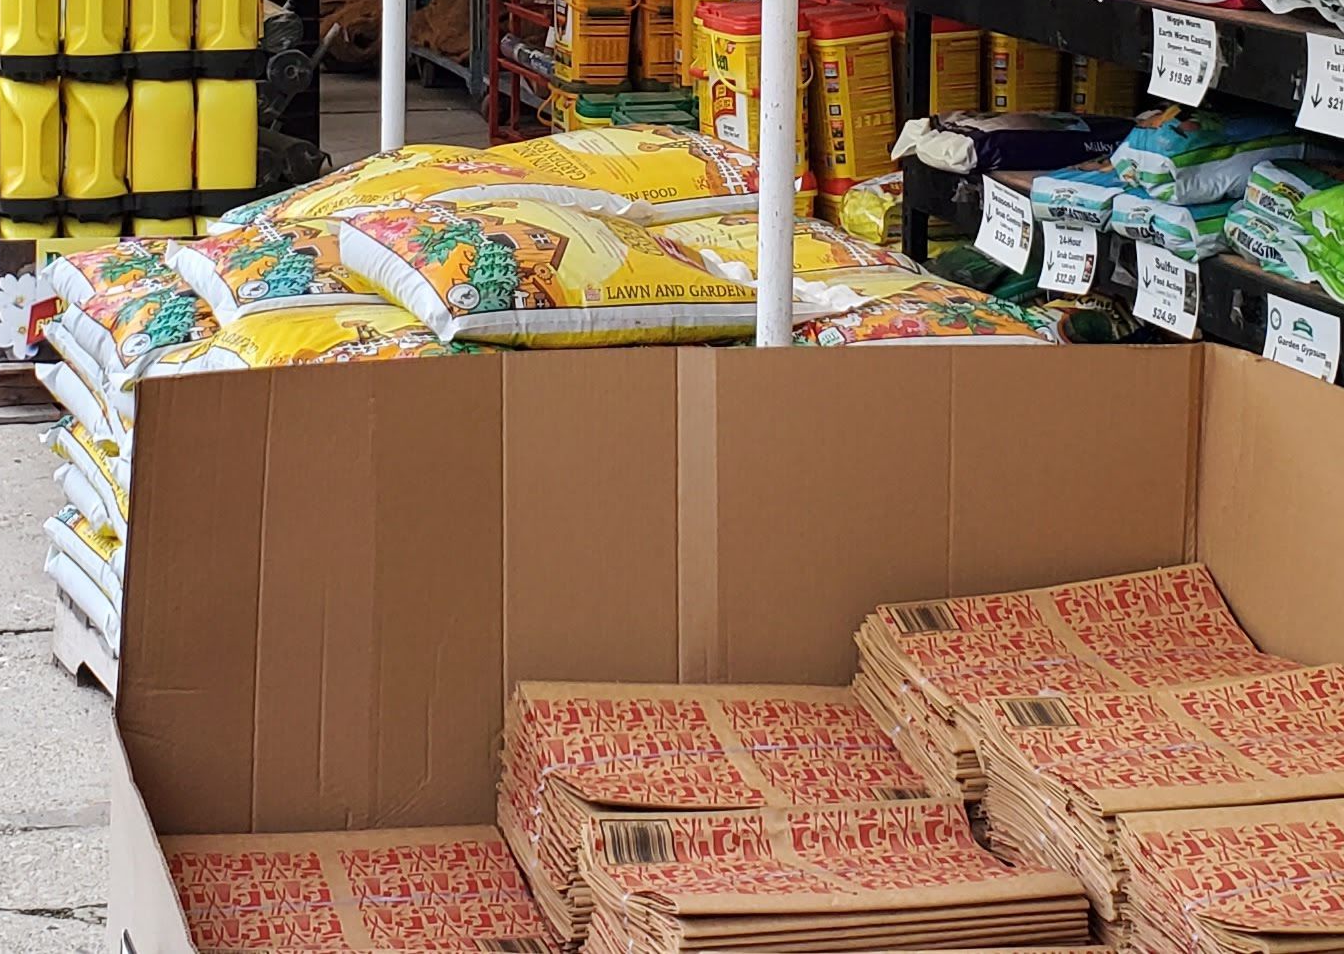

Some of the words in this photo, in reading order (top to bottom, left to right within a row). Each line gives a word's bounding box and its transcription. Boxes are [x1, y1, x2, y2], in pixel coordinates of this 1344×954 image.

[1159, 27, 1172, 38] Earth
[1174, 31, 1189, 41] Worm
[1326, 61, 1341, 72] Fast
[1169, 70, 1193, 86] $19.99
[1084, 141, 1114, 153] Milky
[643, 187, 678, 202] FOOD
[994, 229, 1015, 249] $32.99
[1058, 235, 1082, 247] 24-Hour
[1155, 257, 1179, 276] Sulfur
[1054, 272, 1076, 286] $32.99
[607, 284, 651, 300] LAWN
[656, 284, 685, 297] AND
[689, 284, 746, 298] GARDEN
[1152, 307, 1177, 327] $24.99
[1277, 335, 1300, 351] Garden
[1301, 343, 1327, 362] Gypsum
